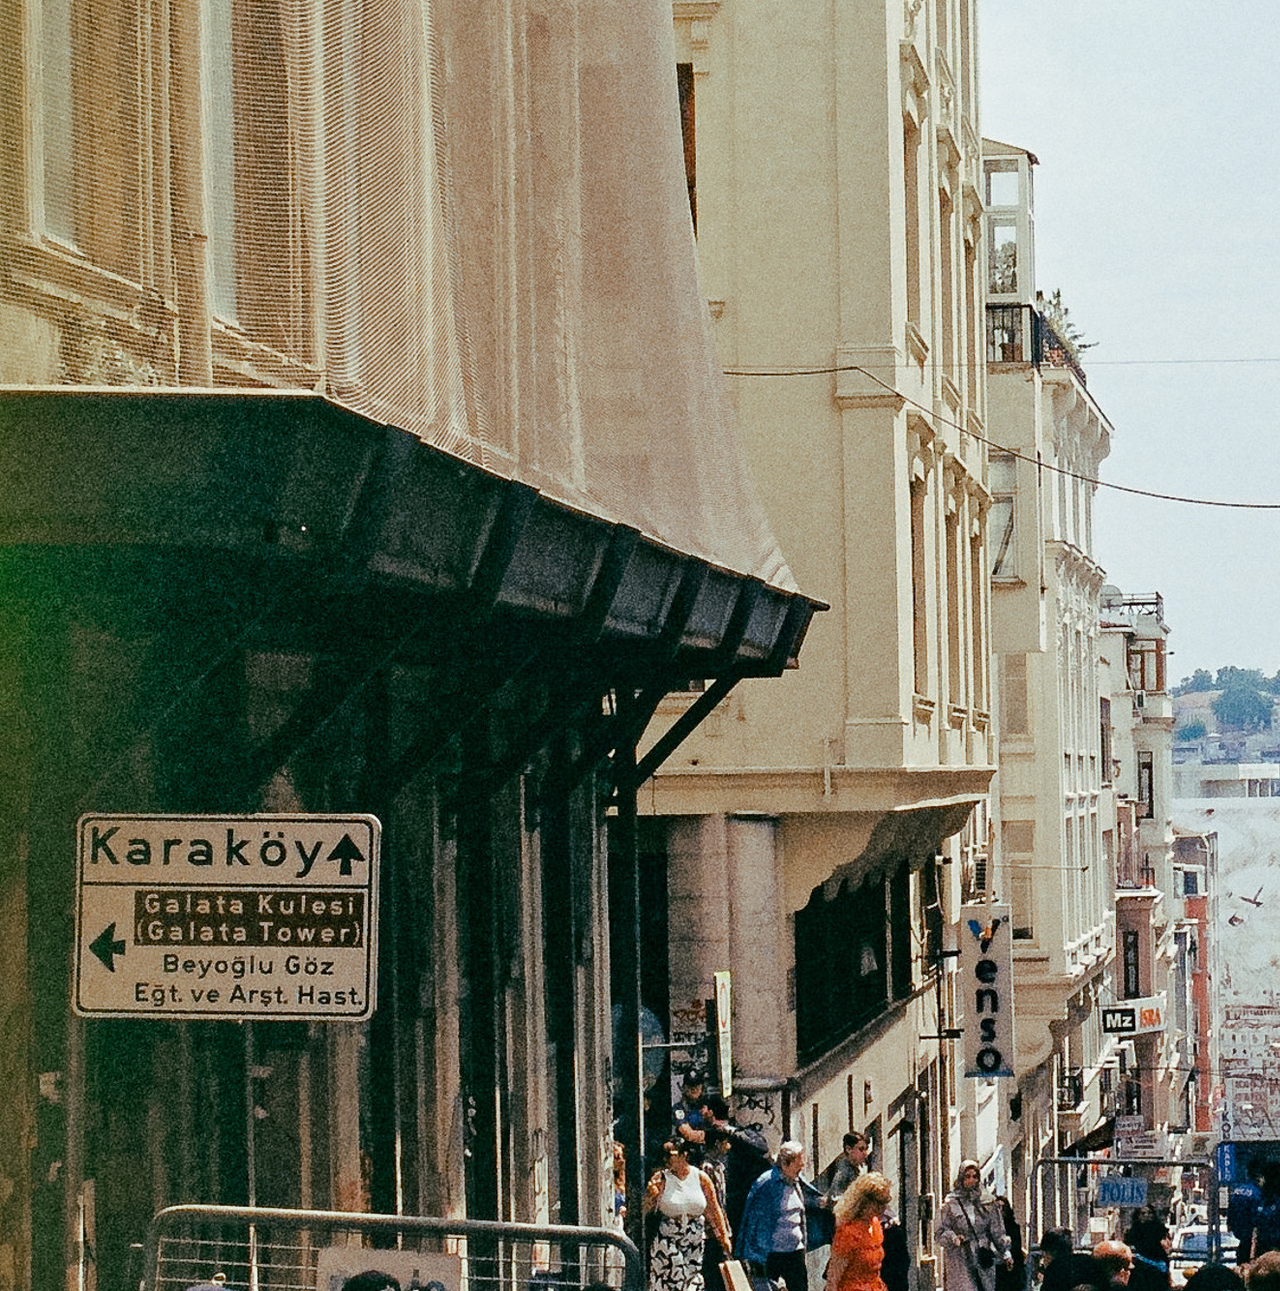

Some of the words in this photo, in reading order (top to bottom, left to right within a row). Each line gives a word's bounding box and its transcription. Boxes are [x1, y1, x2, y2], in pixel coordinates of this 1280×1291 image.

[89, 825, 324, 878] Karaköy
[145, 894, 243, 914] Galata
[258, 895, 354, 915] Kulesi
[137, 921, 247, 943] (Galata
[259, 921, 362, 945] Tower)
[163, 953, 273, 978] Beyoğlu
[285, 955, 335, 975] Göz
[135, 982, 182, 1006] Eğt.
[191, 988, 220, 1003] ve
[229, 984, 288, 1007] Arşt.
[298, 985, 363, 1006] Hast.
[1106, 1013, 1133, 1028] Mz
